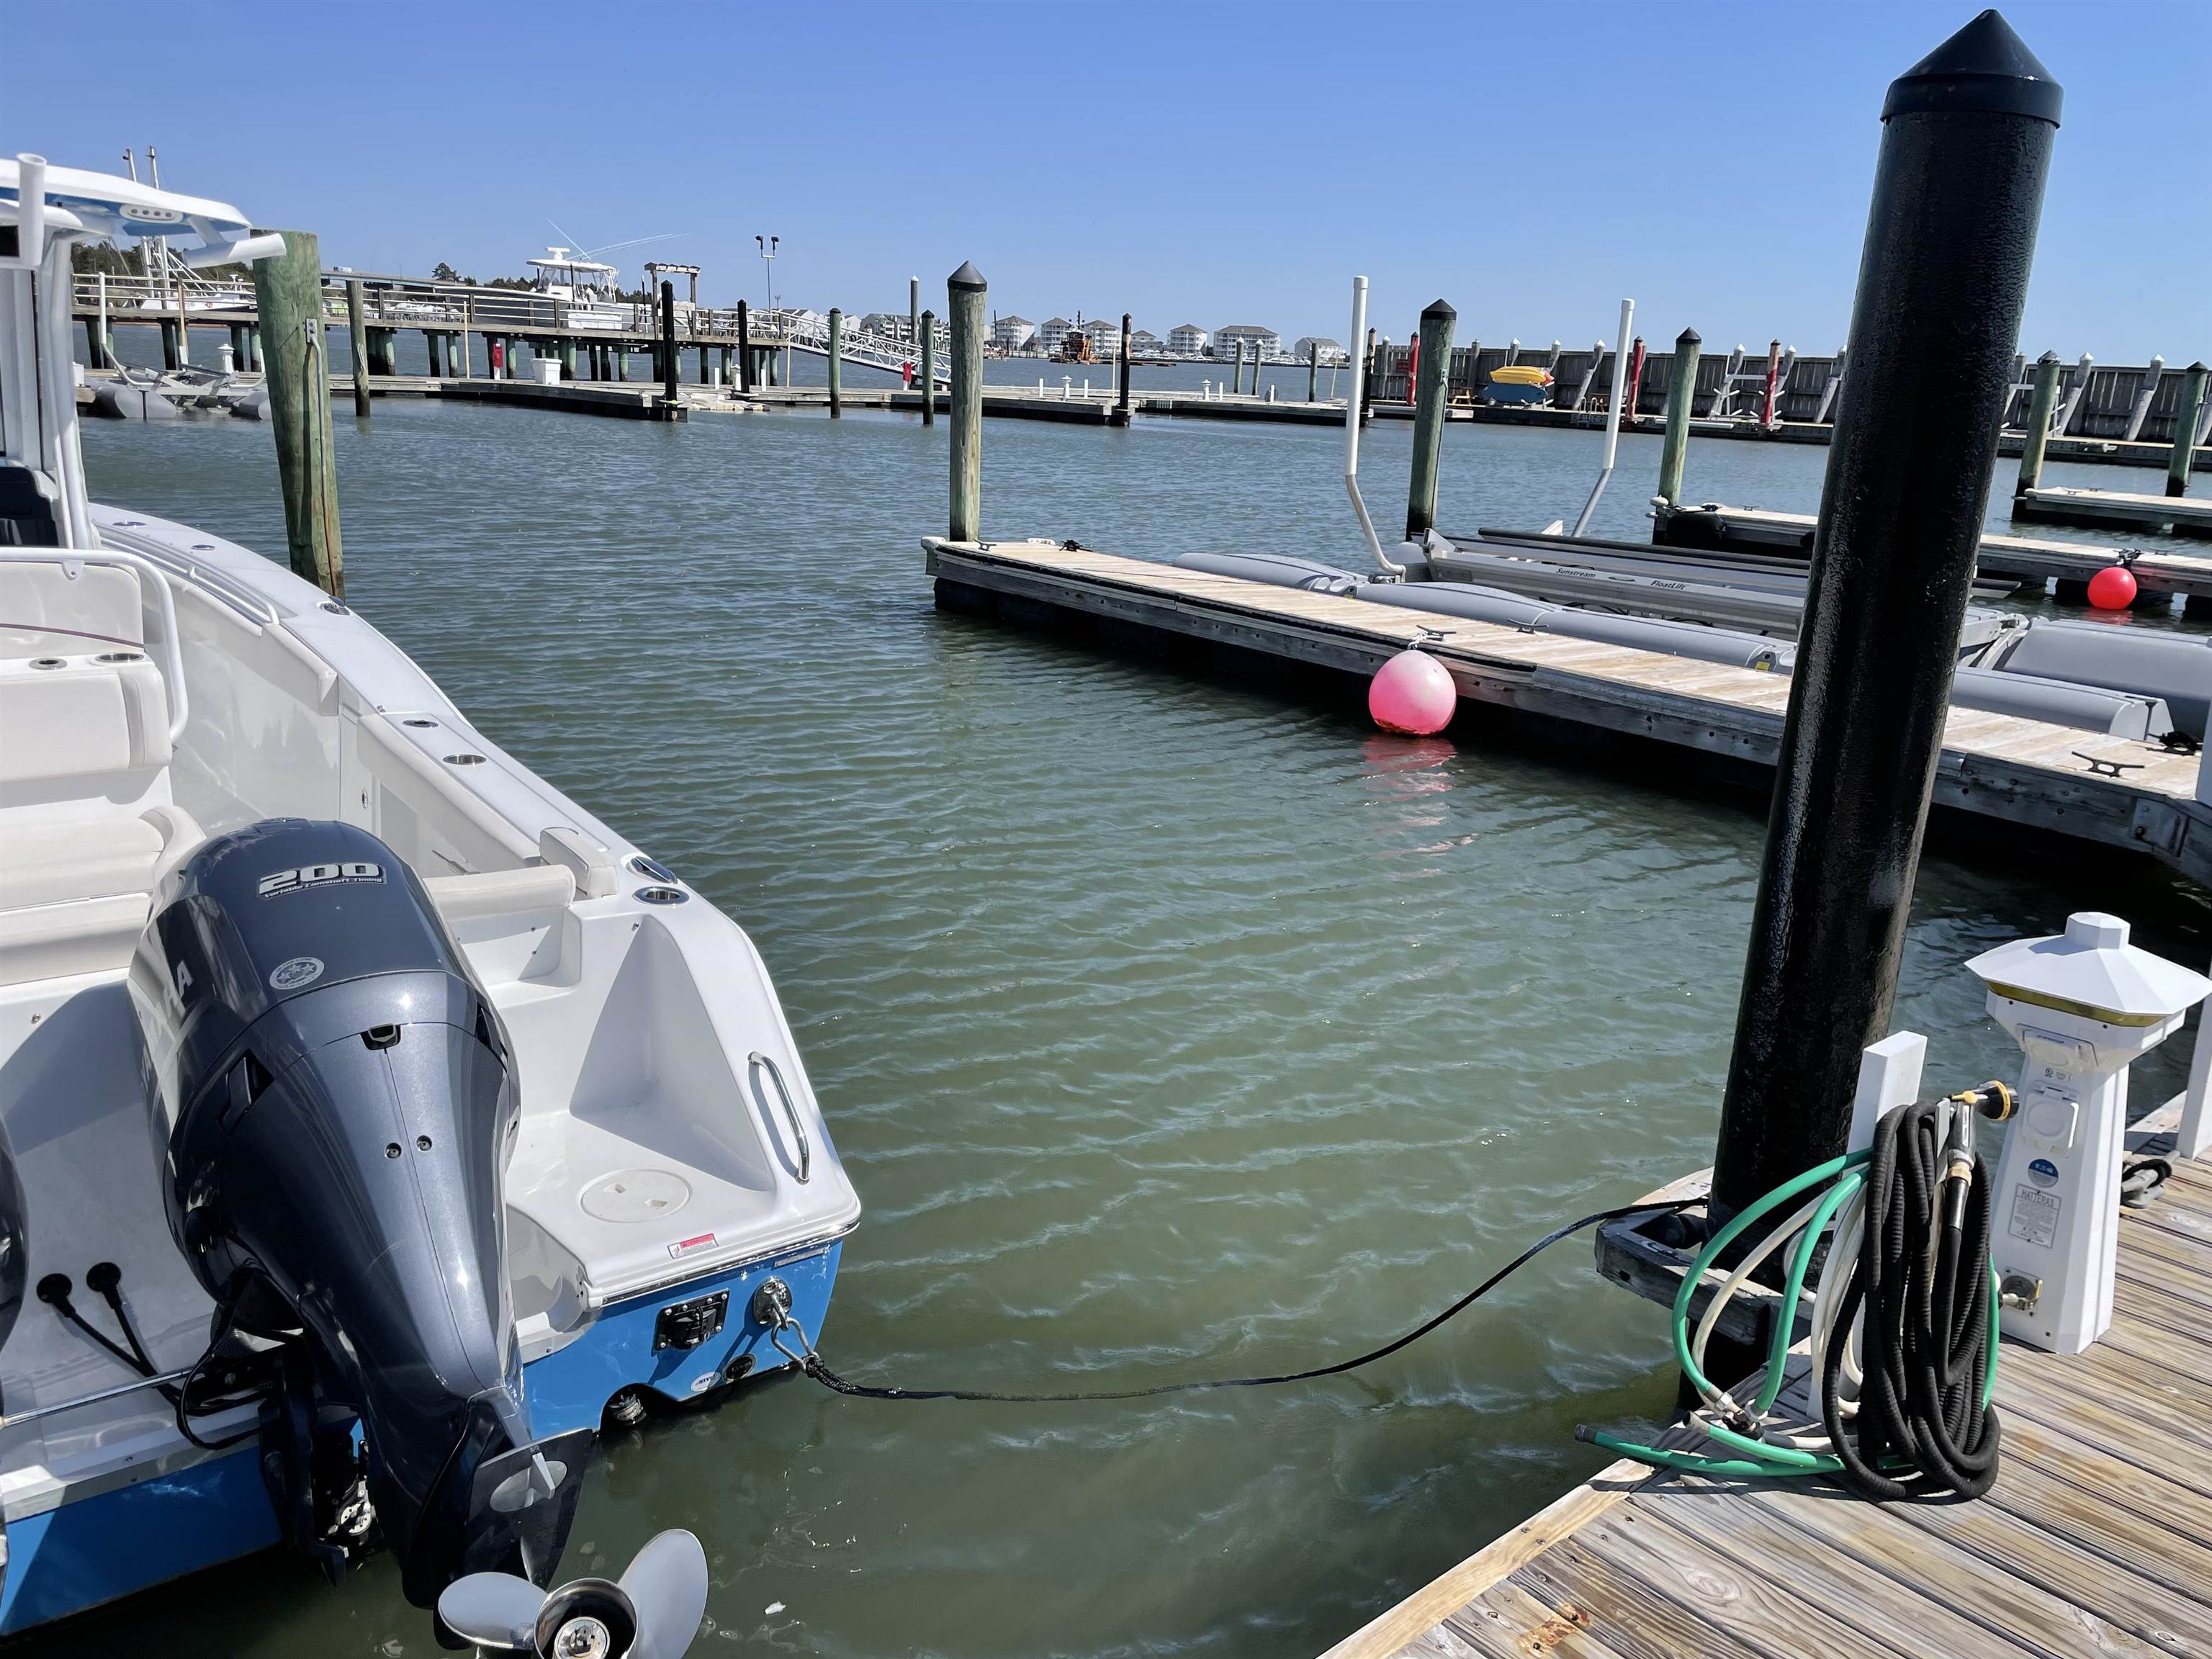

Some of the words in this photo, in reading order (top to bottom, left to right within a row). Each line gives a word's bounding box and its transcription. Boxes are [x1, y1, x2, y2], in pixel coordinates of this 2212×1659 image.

[1555, 567, 1596, 578] Sunstream
[1650, 580, 1686, 590] FloatLift
[259, 863, 379, 894] 200
[264, 884, 304, 898] Variable
[305, 877, 350, 889] Camshaft
[2020, 1188, 2055, 1208] HATTERAS
